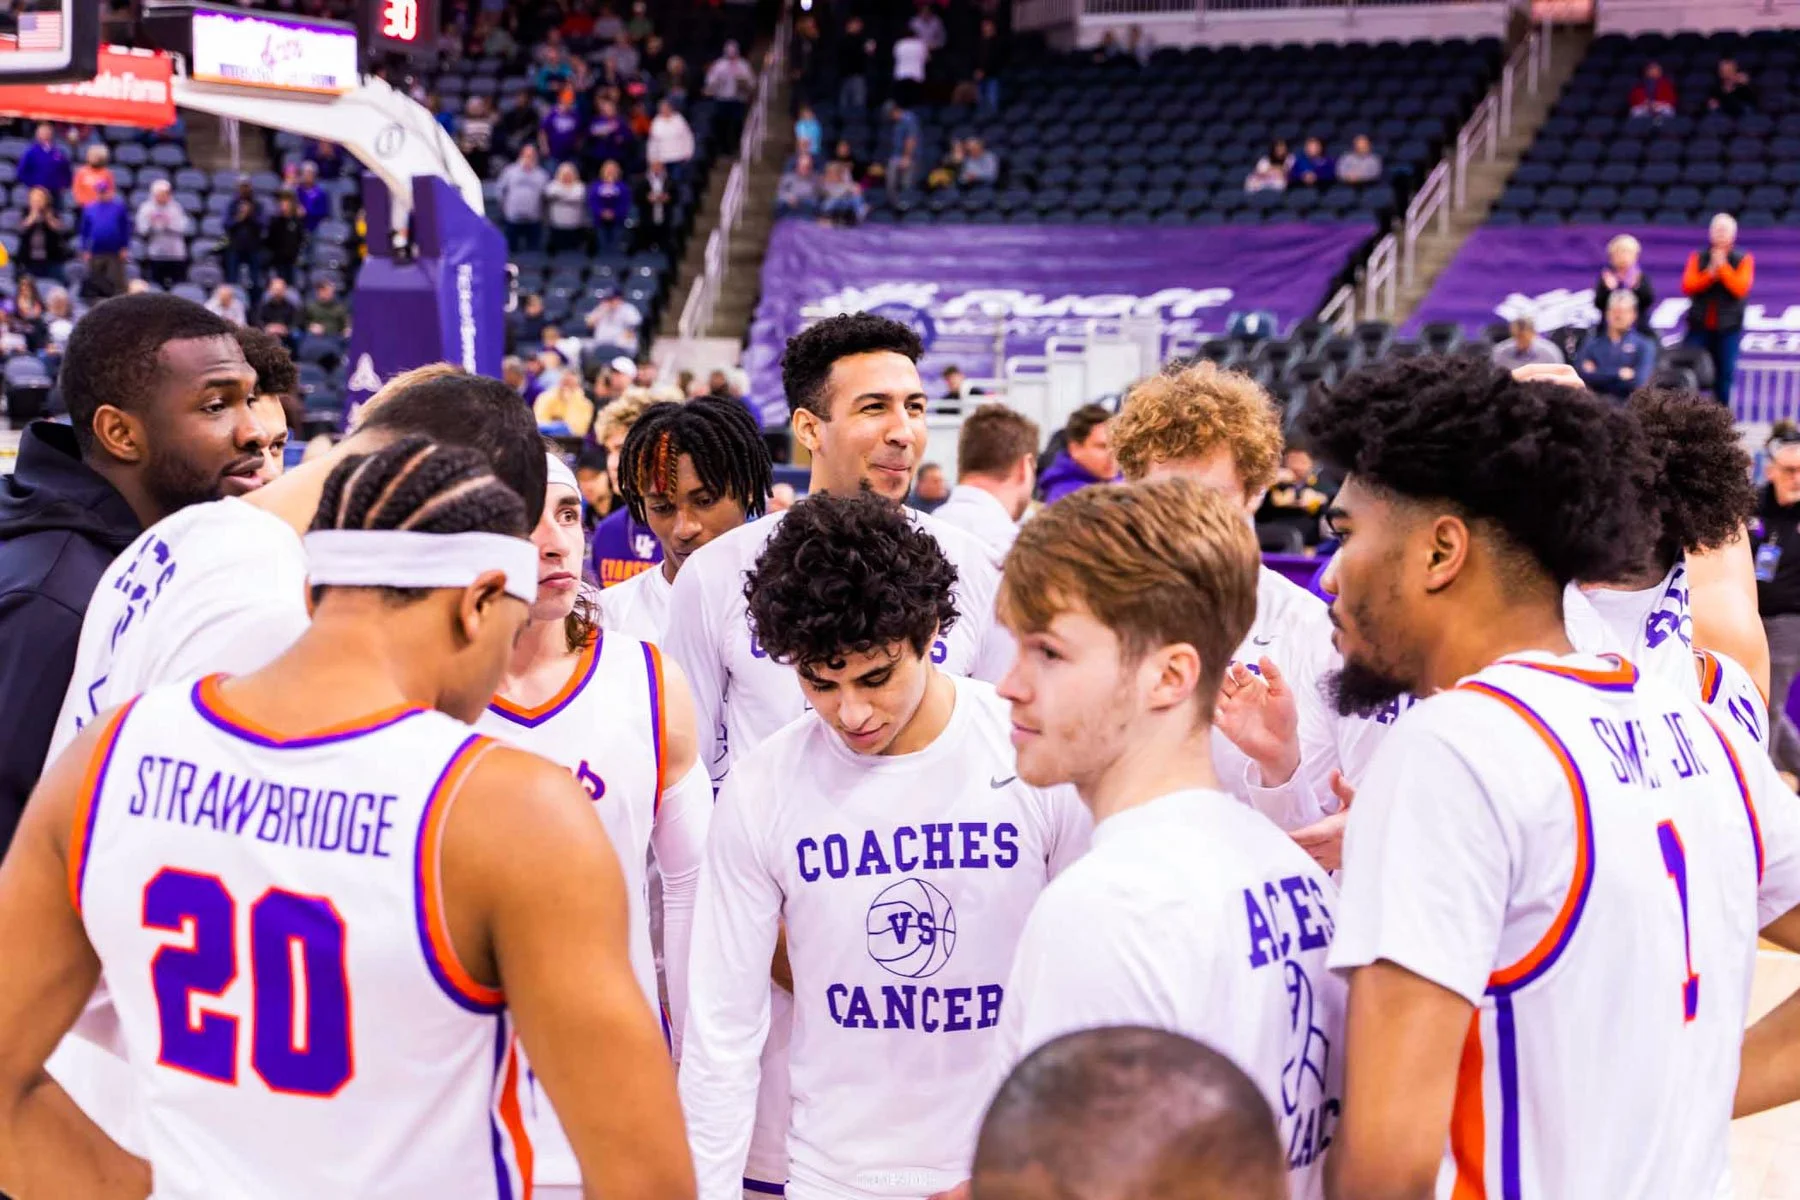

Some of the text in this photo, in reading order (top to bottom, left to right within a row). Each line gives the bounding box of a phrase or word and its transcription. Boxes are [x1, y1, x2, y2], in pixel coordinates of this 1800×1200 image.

[383, 0, 417, 40] 30
[129, 755, 399, 858] STRAWBRIDGE
[796, 822, 1020, 883] COACHES
[888, 911, 936, 946] VS
[1656, 819, 1700, 1024] 1
[141, 865, 356, 1099] 20
[826, 982, 1005, 1034] CANCER
